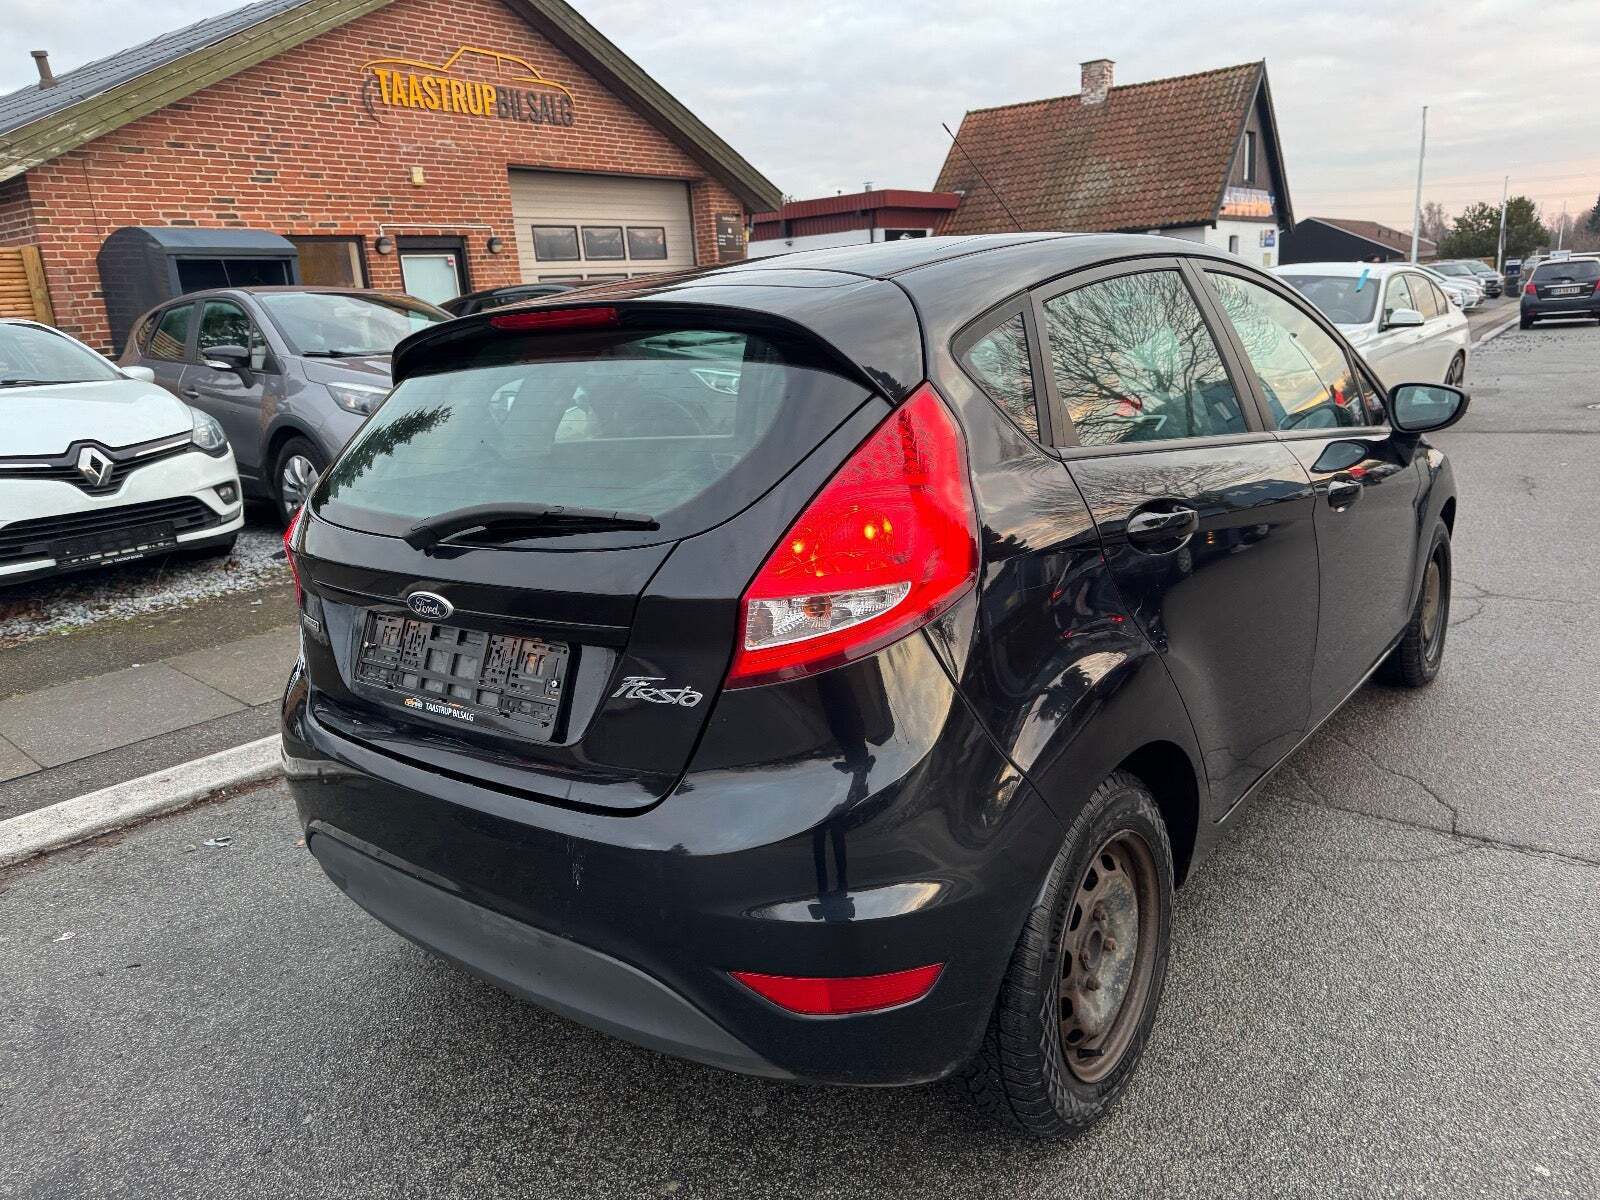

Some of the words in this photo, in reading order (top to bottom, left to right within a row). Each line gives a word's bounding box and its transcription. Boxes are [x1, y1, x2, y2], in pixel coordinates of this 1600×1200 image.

[415, 596, 440, 616] Ford
[610, 675, 704, 708] Fiesta
[425, 702, 452, 716] TAASTRUP
[452, 708, 475, 722] BILSALG
